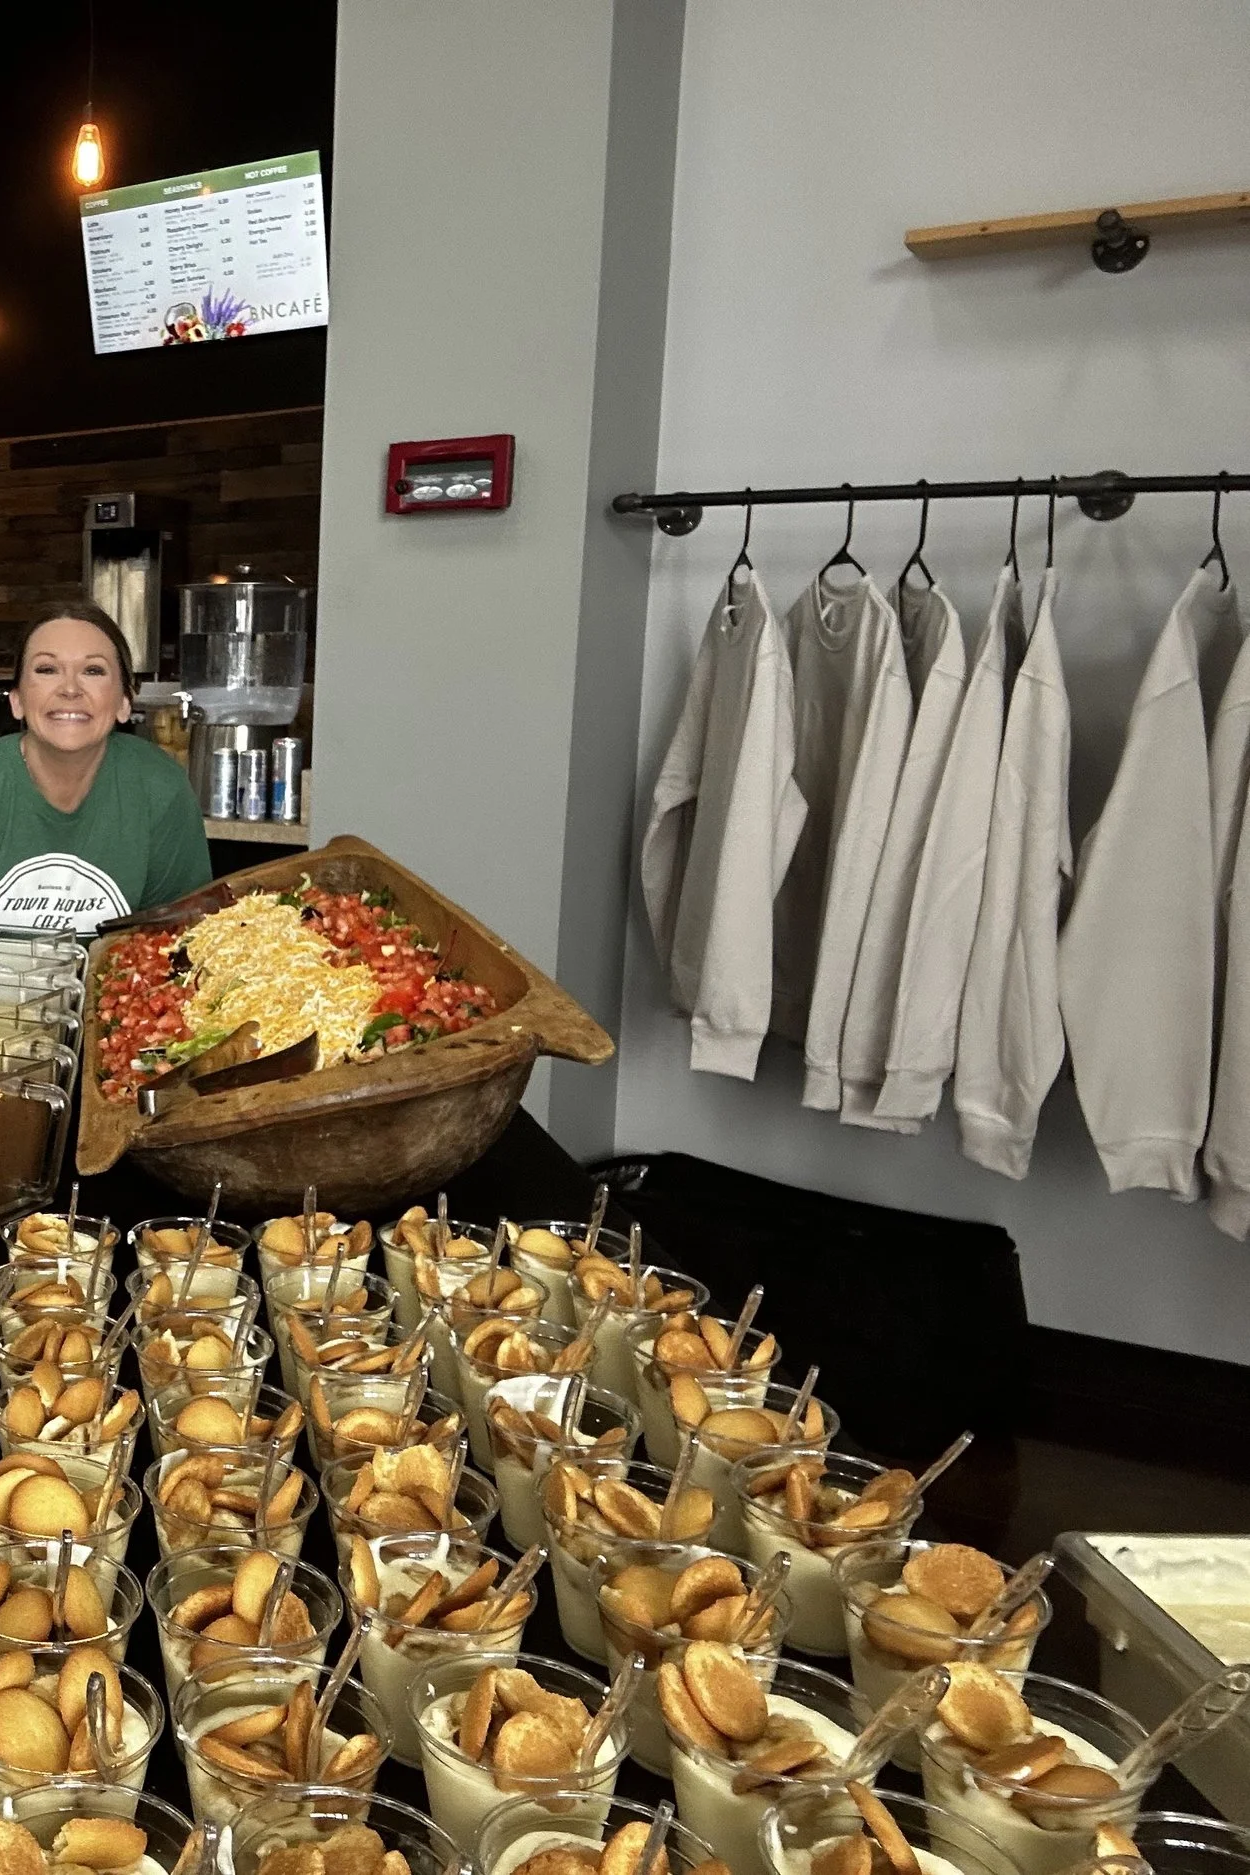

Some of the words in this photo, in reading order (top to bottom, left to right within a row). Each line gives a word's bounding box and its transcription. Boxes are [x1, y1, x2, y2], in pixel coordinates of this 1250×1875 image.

[244, 171, 258, 179] HOT
[260, 165, 287, 176] COFFEE
[163, 181, 202, 194] SEASONALS
[85, 199, 109, 208] COFFEE
[3, 897, 49, 911] TOWN
[53, 896, 107, 912] HOUSE
[32, 914, 73, 929] CAFE
